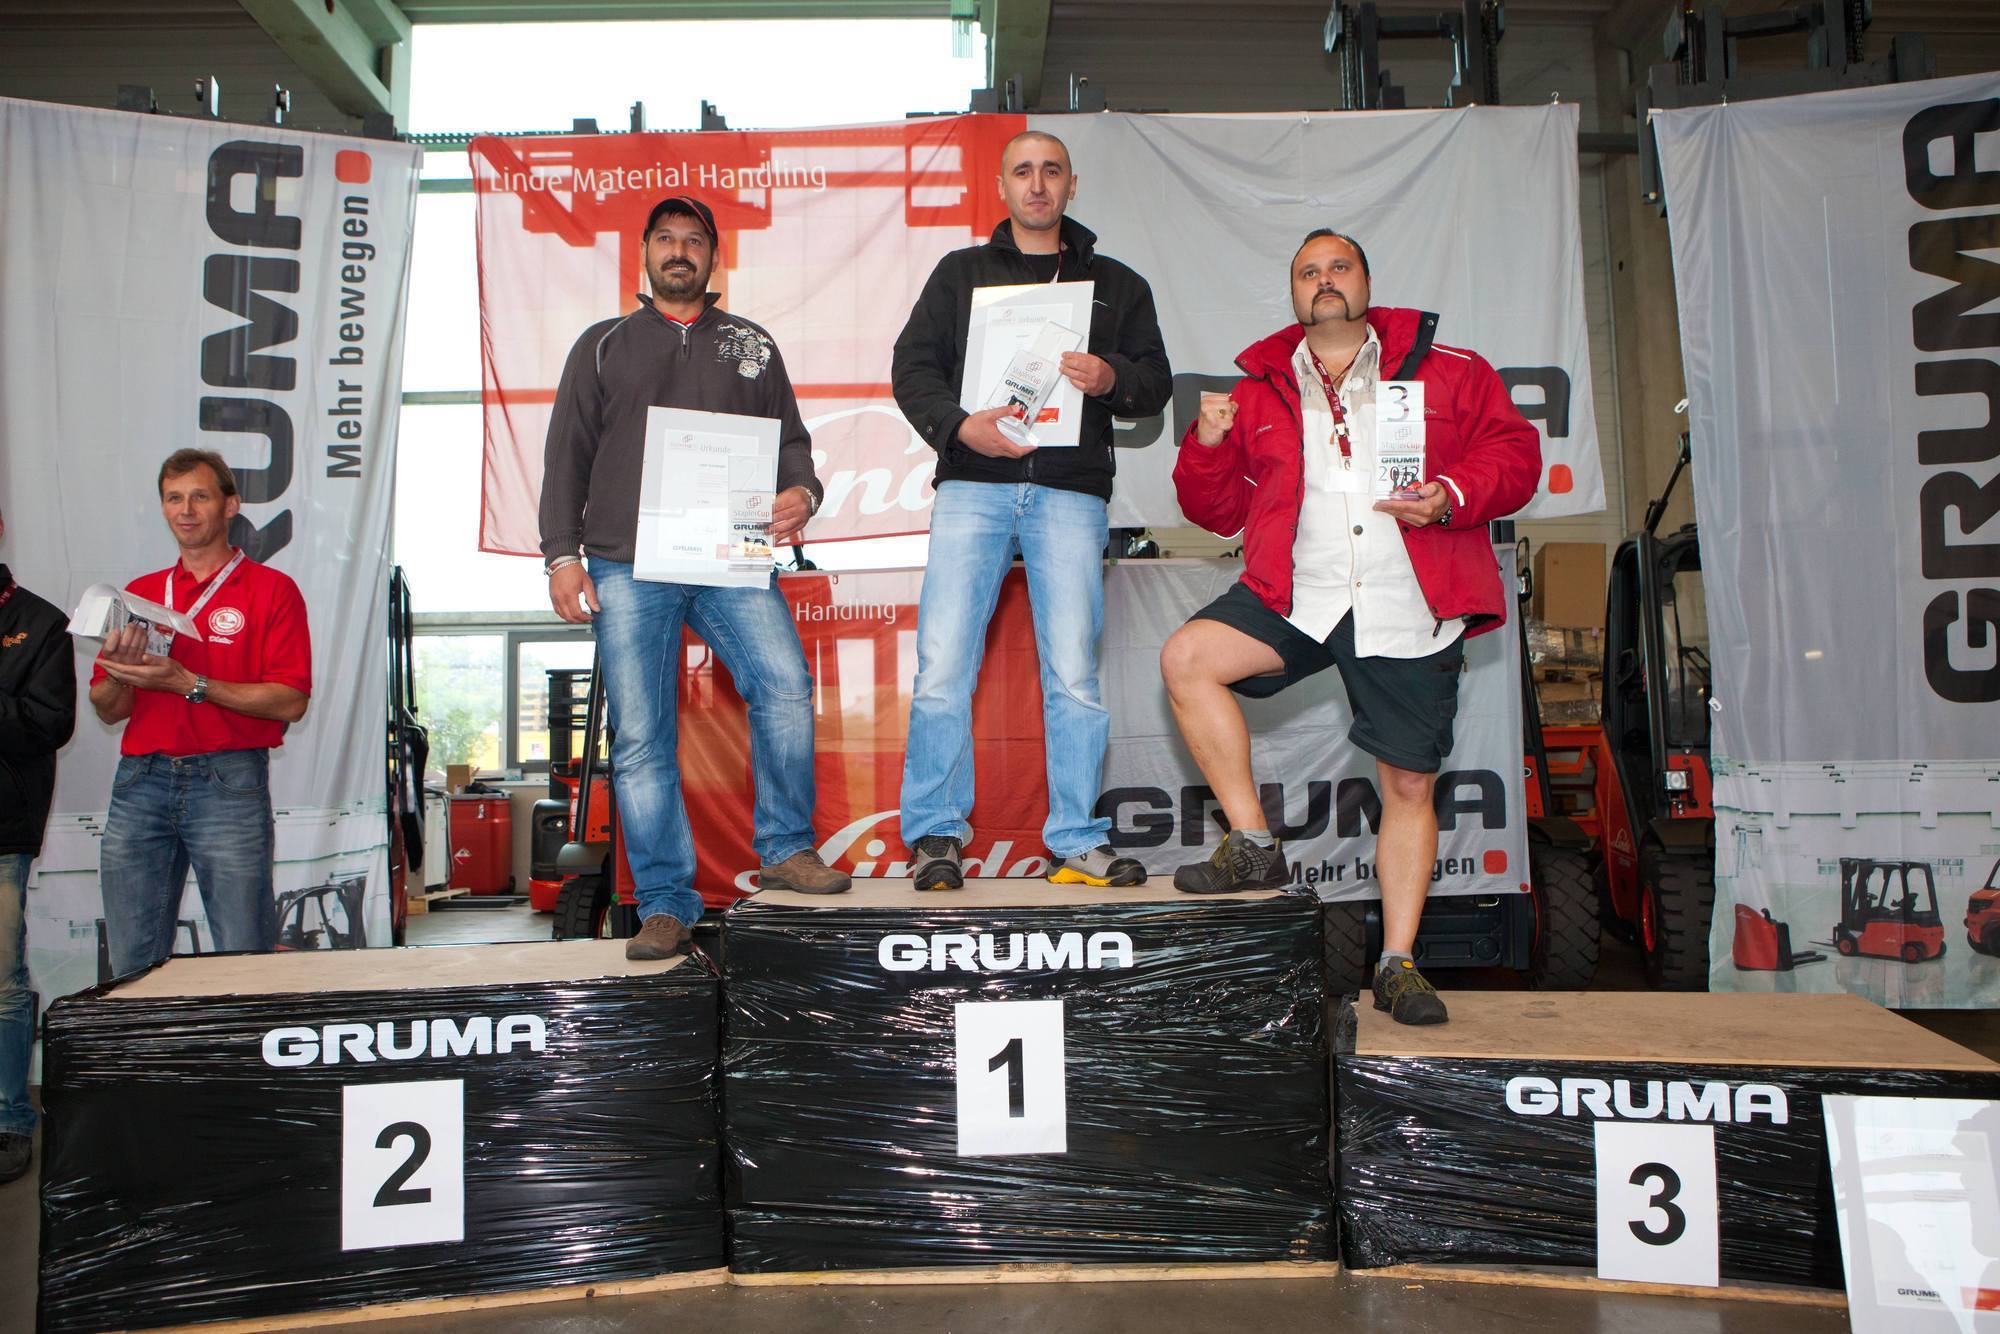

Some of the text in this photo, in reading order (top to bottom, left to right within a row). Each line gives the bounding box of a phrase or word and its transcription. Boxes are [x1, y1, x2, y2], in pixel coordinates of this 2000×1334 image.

[489, 159, 827, 193] Linde Material Handling
[199, 140, 304, 564] UMA
[326, 195, 376, 478] Mehr bewegen
[1005, 379, 1035, 396] GRUMA
[1387, 385, 1410, 421] 3
[1902, 96, 2000, 703] GRUMA
[796, 598, 896, 625] Handling
[1355, 856, 1475, 882] bgen
[878, 931, 1134, 972] GRUMA
[262, 1013, 547, 1068] GRUMA
[988, 1038, 1025, 1118] 1
[1505, 1076, 1789, 1125] GRUMA
[372, 1121, 432, 1208] 2
[1628, 1162, 1687, 1246] 3
